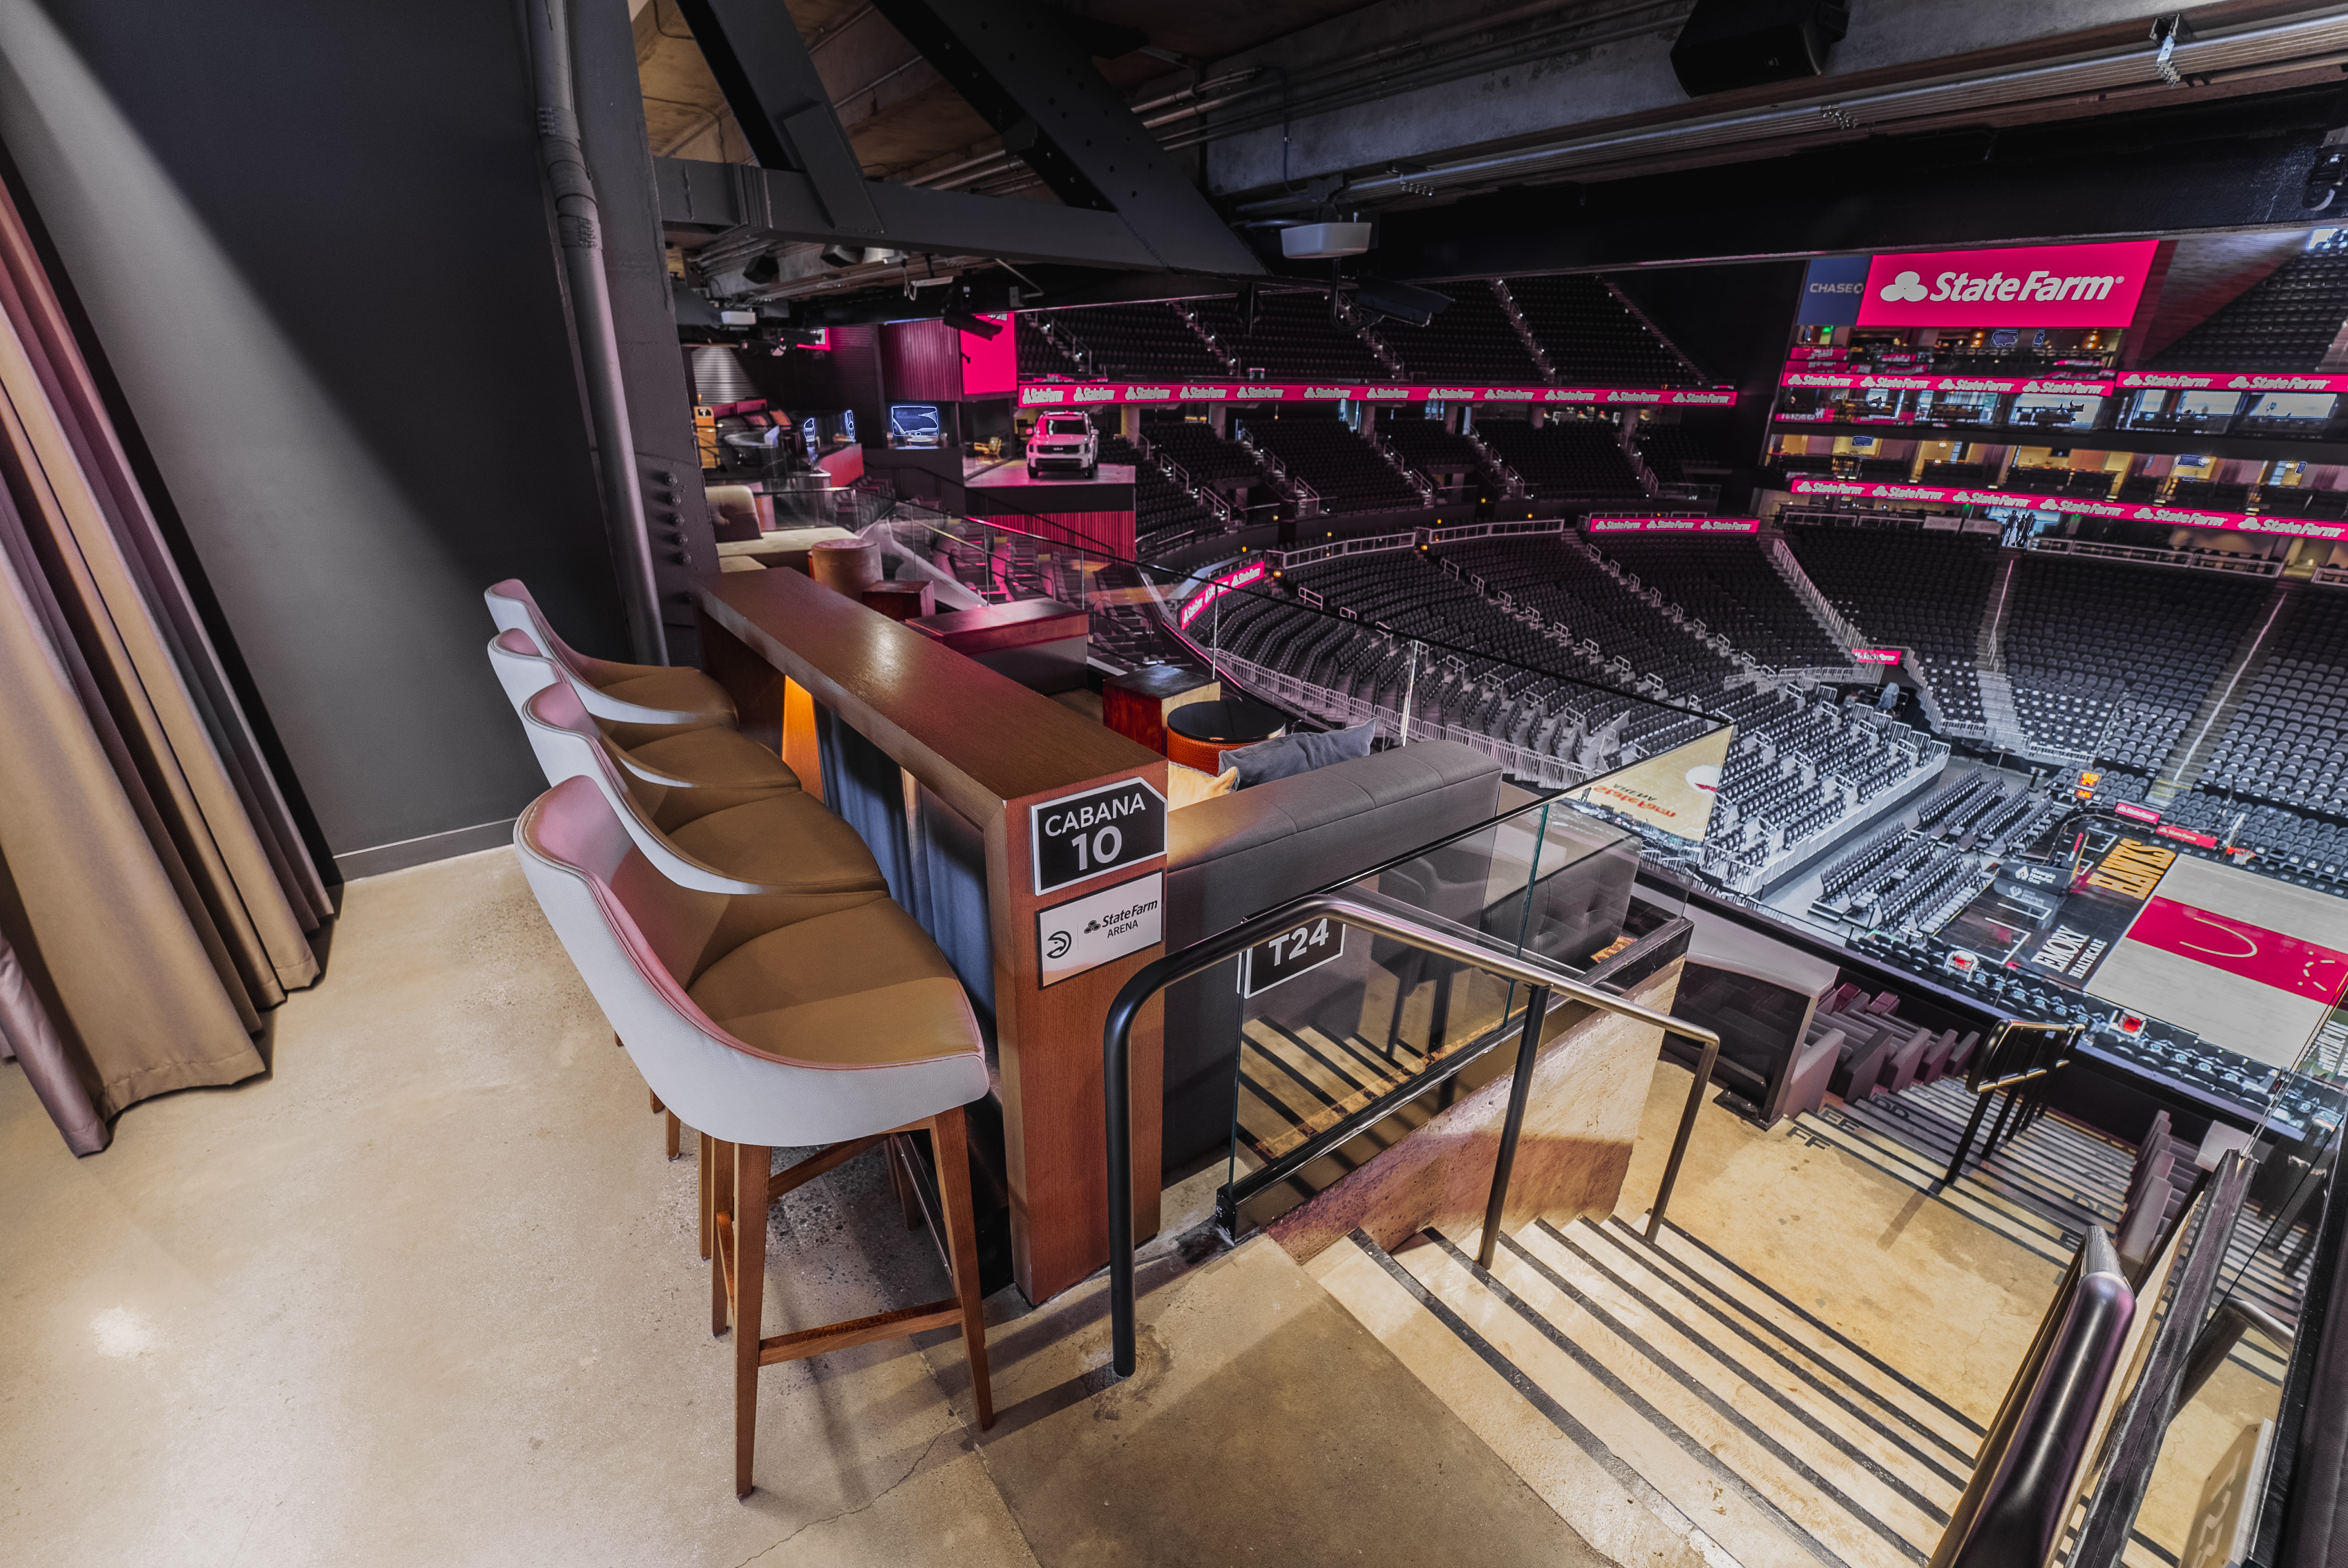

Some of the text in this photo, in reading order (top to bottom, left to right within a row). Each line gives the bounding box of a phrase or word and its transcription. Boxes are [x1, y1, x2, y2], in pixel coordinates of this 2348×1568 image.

[1809, 282, 1853, 294] CHASE
[1045, 793, 1146, 837] CABANA
[1071, 826, 1122, 871] 10
[2086, 838, 2177, 900] HAWKS
[1107, 919, 1139, 938] ARENA
[1268, 918, 1329, 966] T24
[2031, 924, 2090, 973] EMORY
[2068, 938, 2108, 979] HEALTHCARE
[1786, 1126, 1831, 1150] FF
